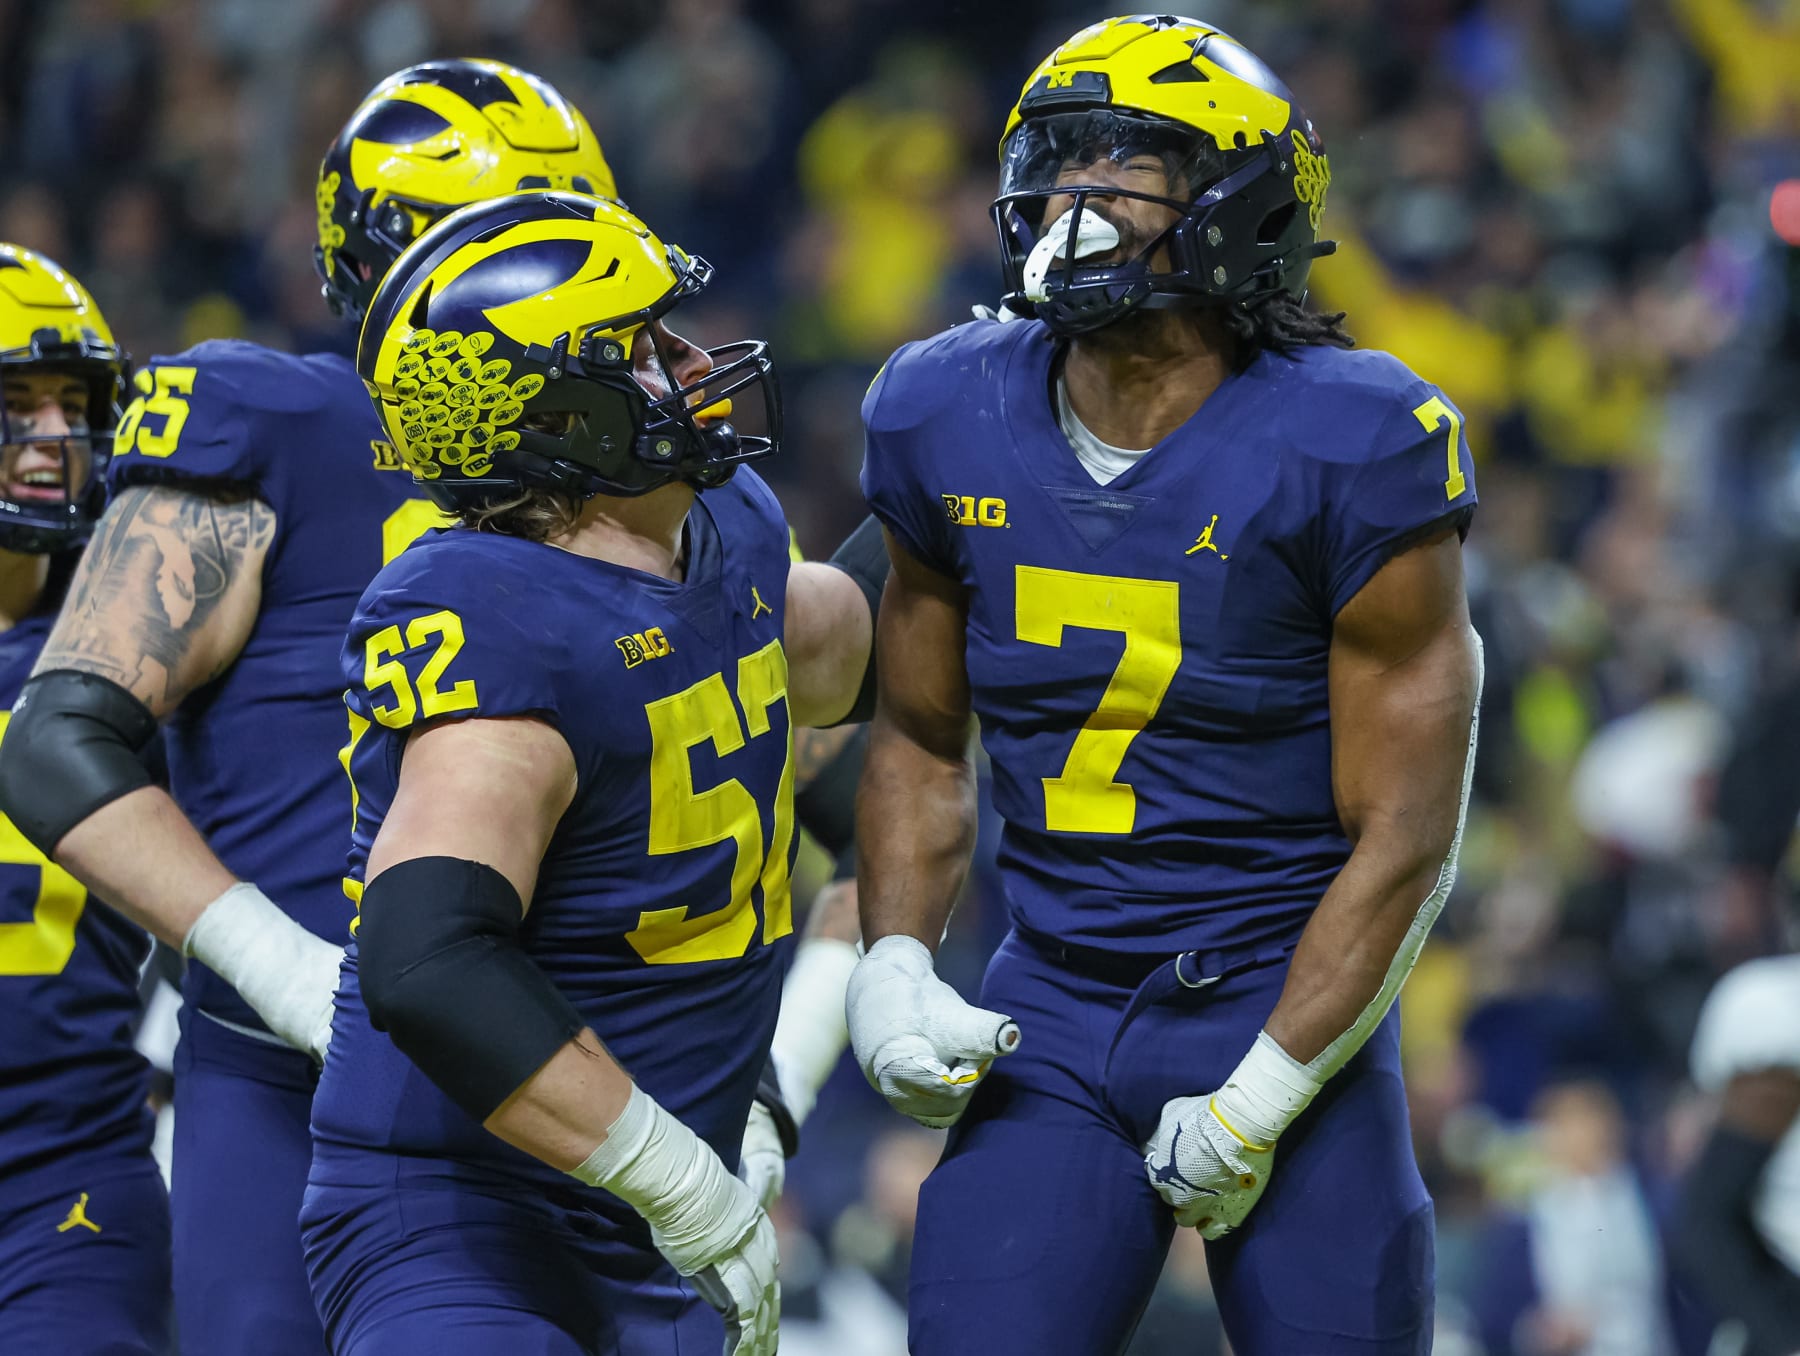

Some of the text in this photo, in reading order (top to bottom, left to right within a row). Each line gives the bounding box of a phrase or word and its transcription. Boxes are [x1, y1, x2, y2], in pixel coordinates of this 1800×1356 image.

[1413, 396, 1466, 501] 7
[363, 609, 479, 729] 52
[1014, 564, 1183, 834] 7
[624, 637, 795, 965] 52
